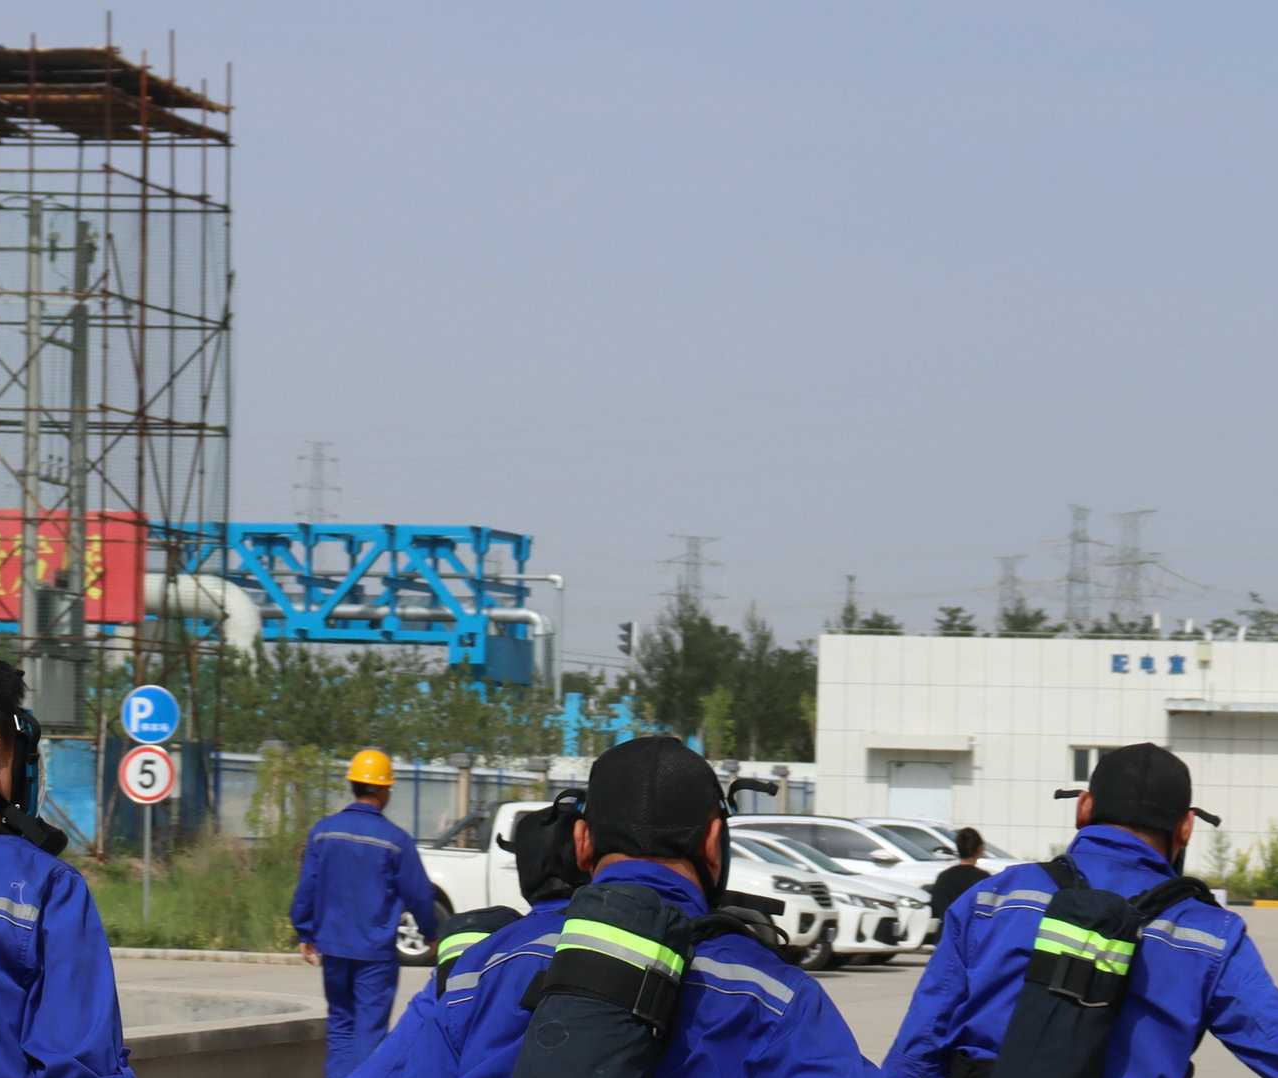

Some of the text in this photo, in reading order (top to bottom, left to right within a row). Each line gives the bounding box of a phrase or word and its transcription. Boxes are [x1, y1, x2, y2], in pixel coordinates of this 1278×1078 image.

[1111, 653, 1186, 674] 配电室
[130, 697, 154, 733] P
[137, 759, 157, 790] 5
